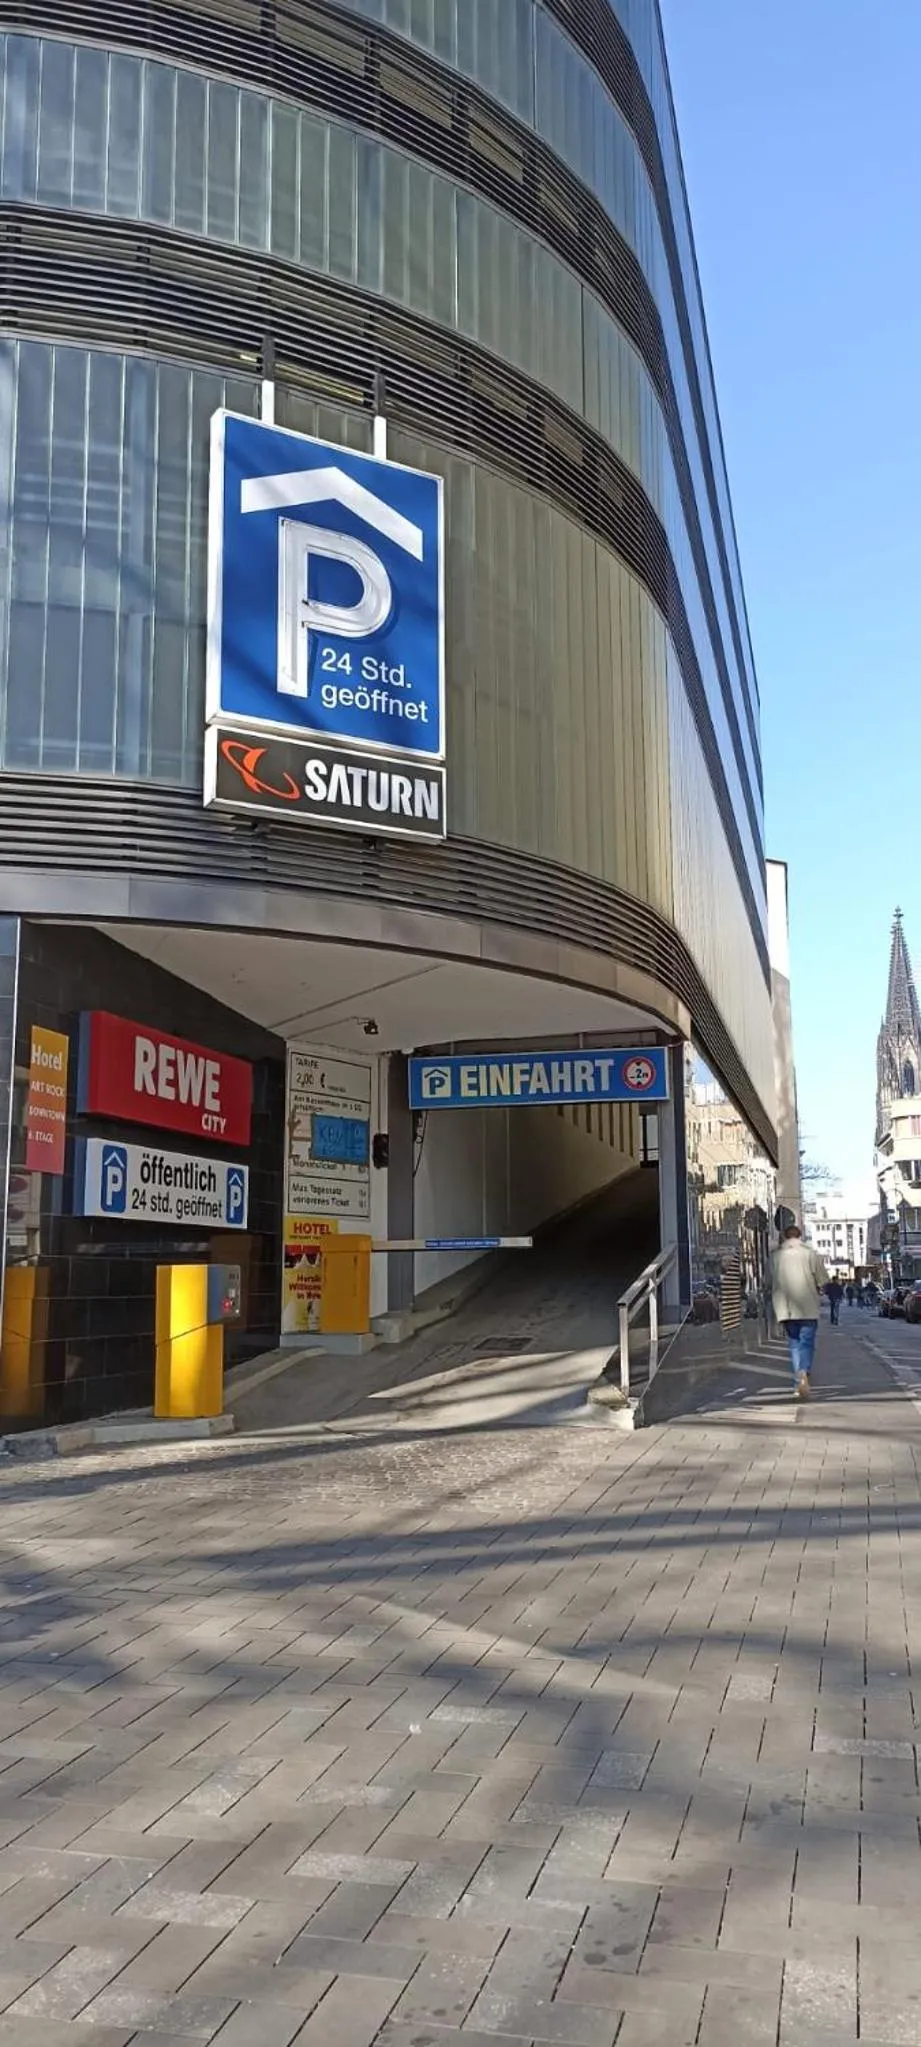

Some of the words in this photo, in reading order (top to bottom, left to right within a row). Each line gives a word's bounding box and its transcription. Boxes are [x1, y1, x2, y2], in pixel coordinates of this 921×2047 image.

[277, 515, 392, 698] P
[321, 647, 352, 676] 24
[361, 656, 413, 690] Std.
[320, 684, 430, 722] geöffnet
[304, 759, 439, 821] SATURN
[31, 1044, 63, 1071] Hotel
[133, 1035, 222, 1113] REWE
[31, 1080, 45, 1094] ART
[429, 1077, 446, 1095] P
[460, 1059, 614, 1097] EINFAHRT
[201, 1113, 227, 1135] CITY
[106, 1165, 123, 1206] P
[140, 1153, 217, 1193] öffentlich
[132, 1188, 147, 1210] 24
[150, 1191, 173, 1214] std.
[176, 1194, 222, 1219] geöffnet
[230, 1185, 242, 1218] P
[293, 1222, 332, 1235] HOTEL
